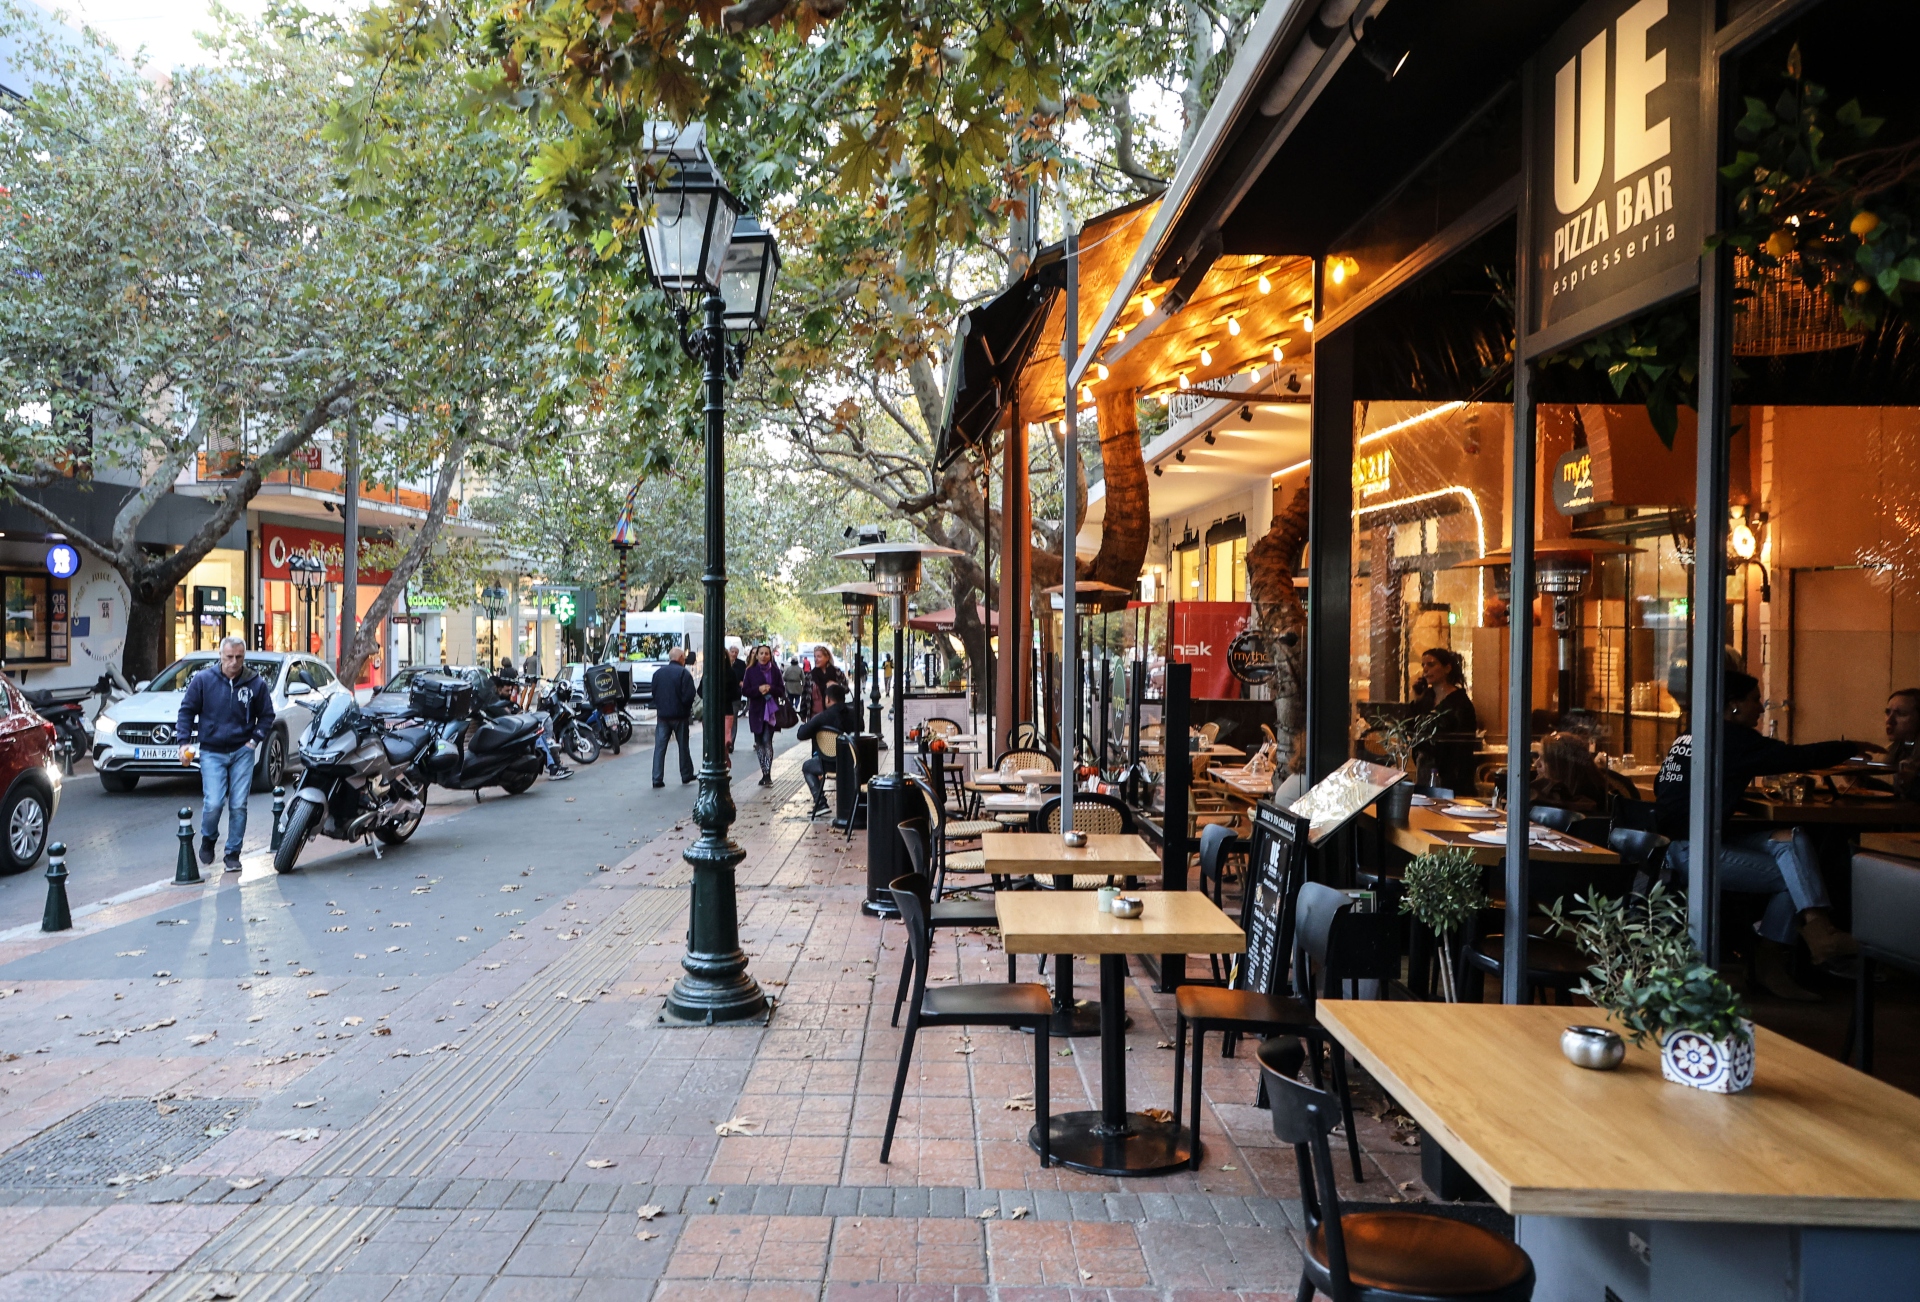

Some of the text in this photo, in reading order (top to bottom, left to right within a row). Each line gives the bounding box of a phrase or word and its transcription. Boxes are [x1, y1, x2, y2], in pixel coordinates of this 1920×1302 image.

[1553, 165, 1673, 270] PIZZA BAR
[1553, 222, 1676, 297] espresseria
